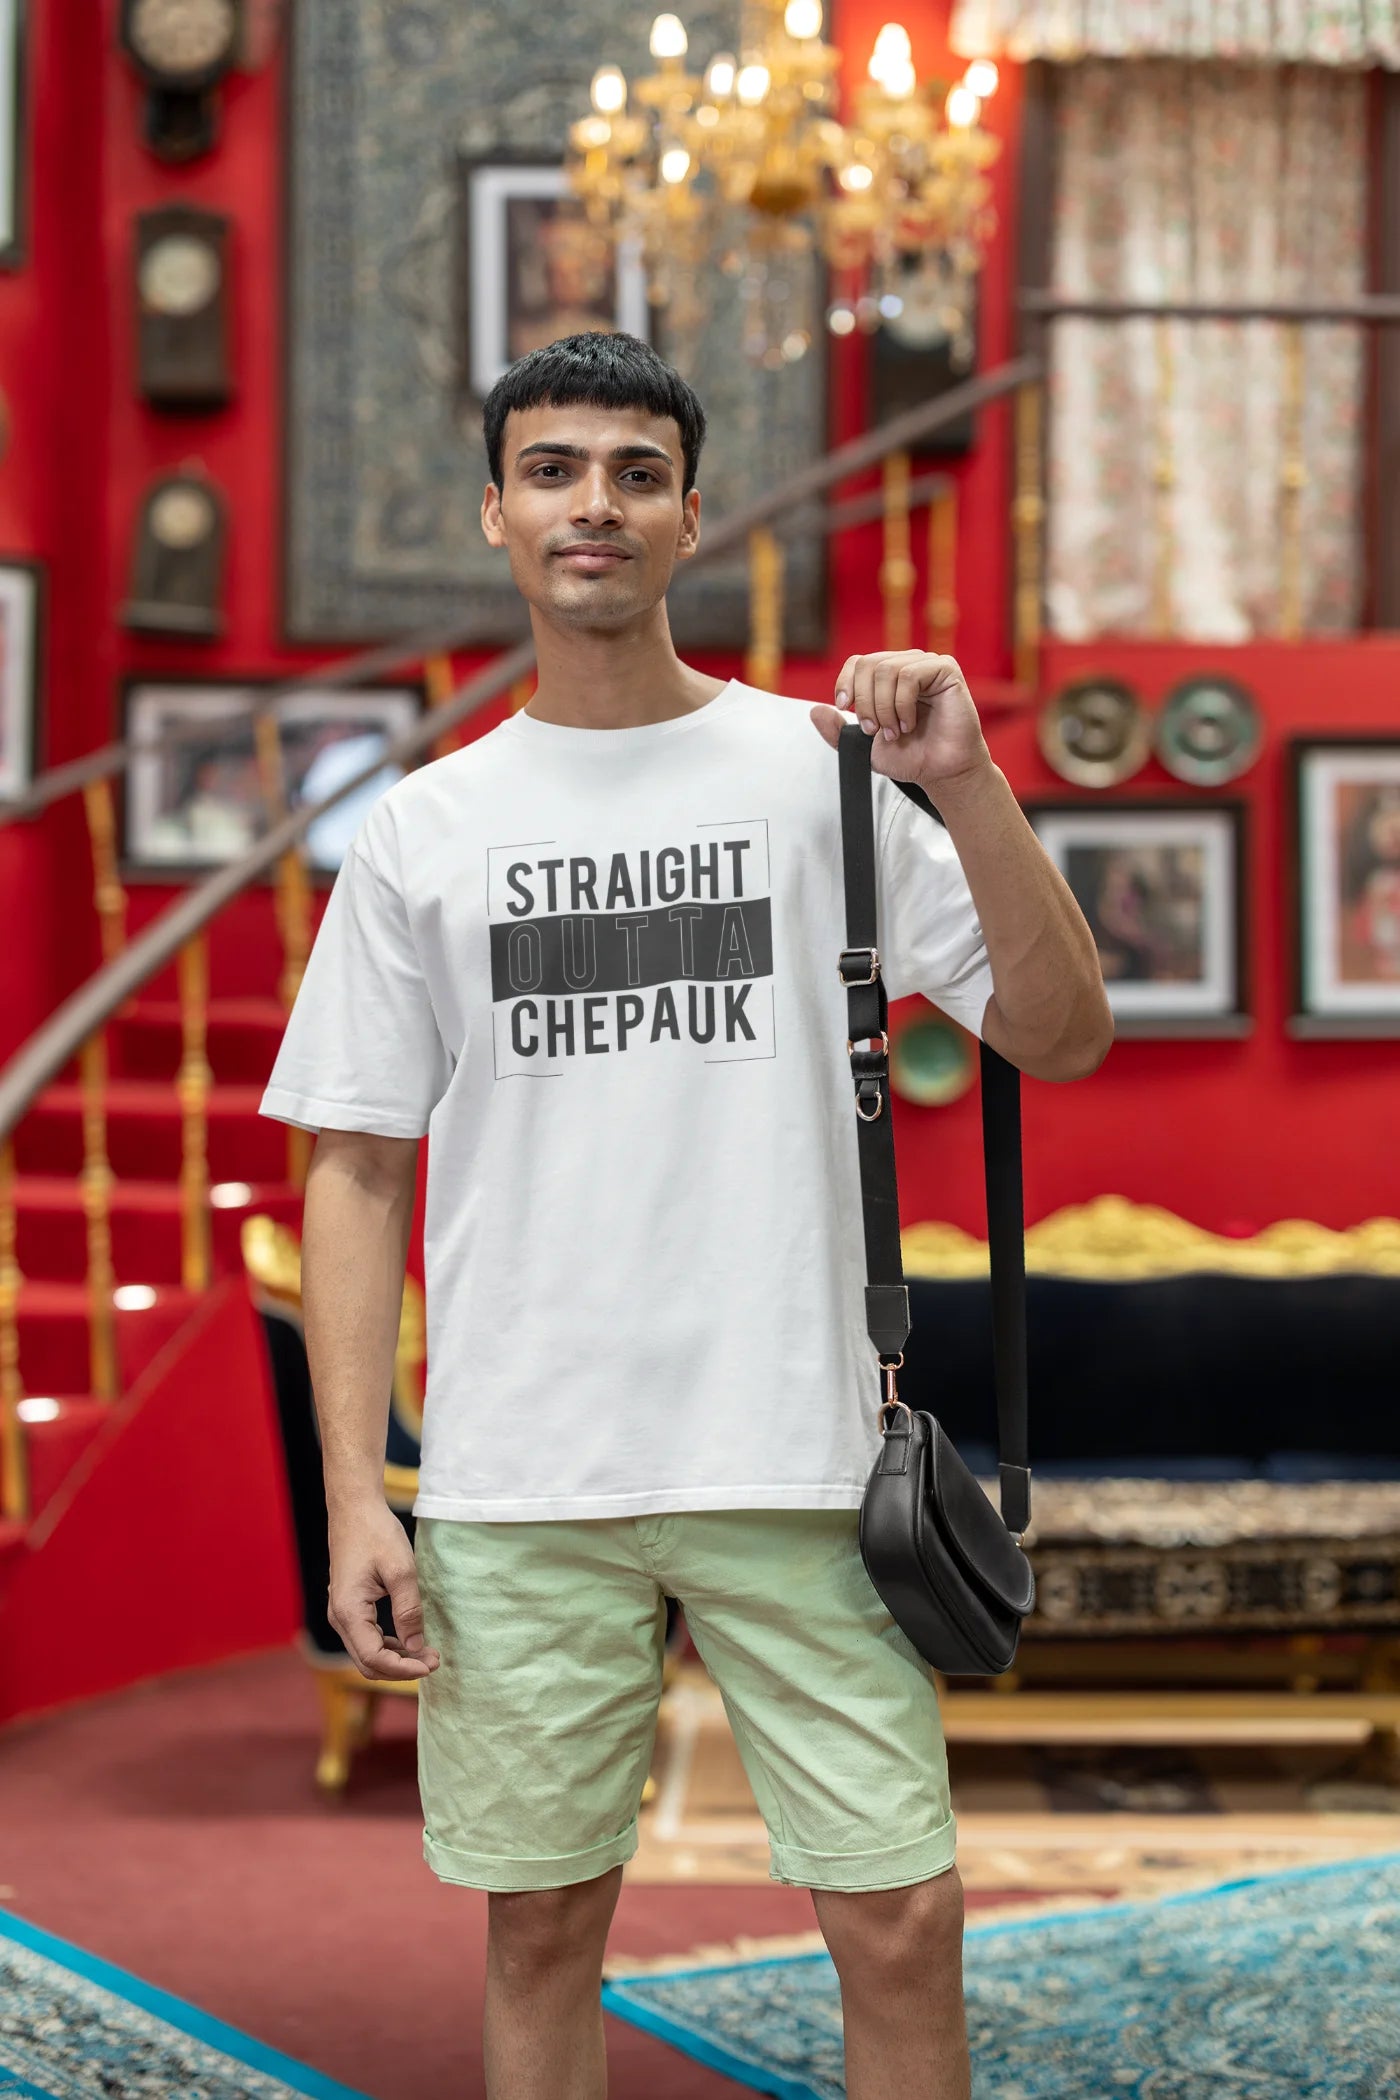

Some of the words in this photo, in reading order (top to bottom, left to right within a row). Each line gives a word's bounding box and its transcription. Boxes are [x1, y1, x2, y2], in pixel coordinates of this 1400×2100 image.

[506, 839, 750, 917] STRAIGHT
[507, 906, 755, 992] OUTTA
[511, 983, 757, 1057] CHEPAUK
